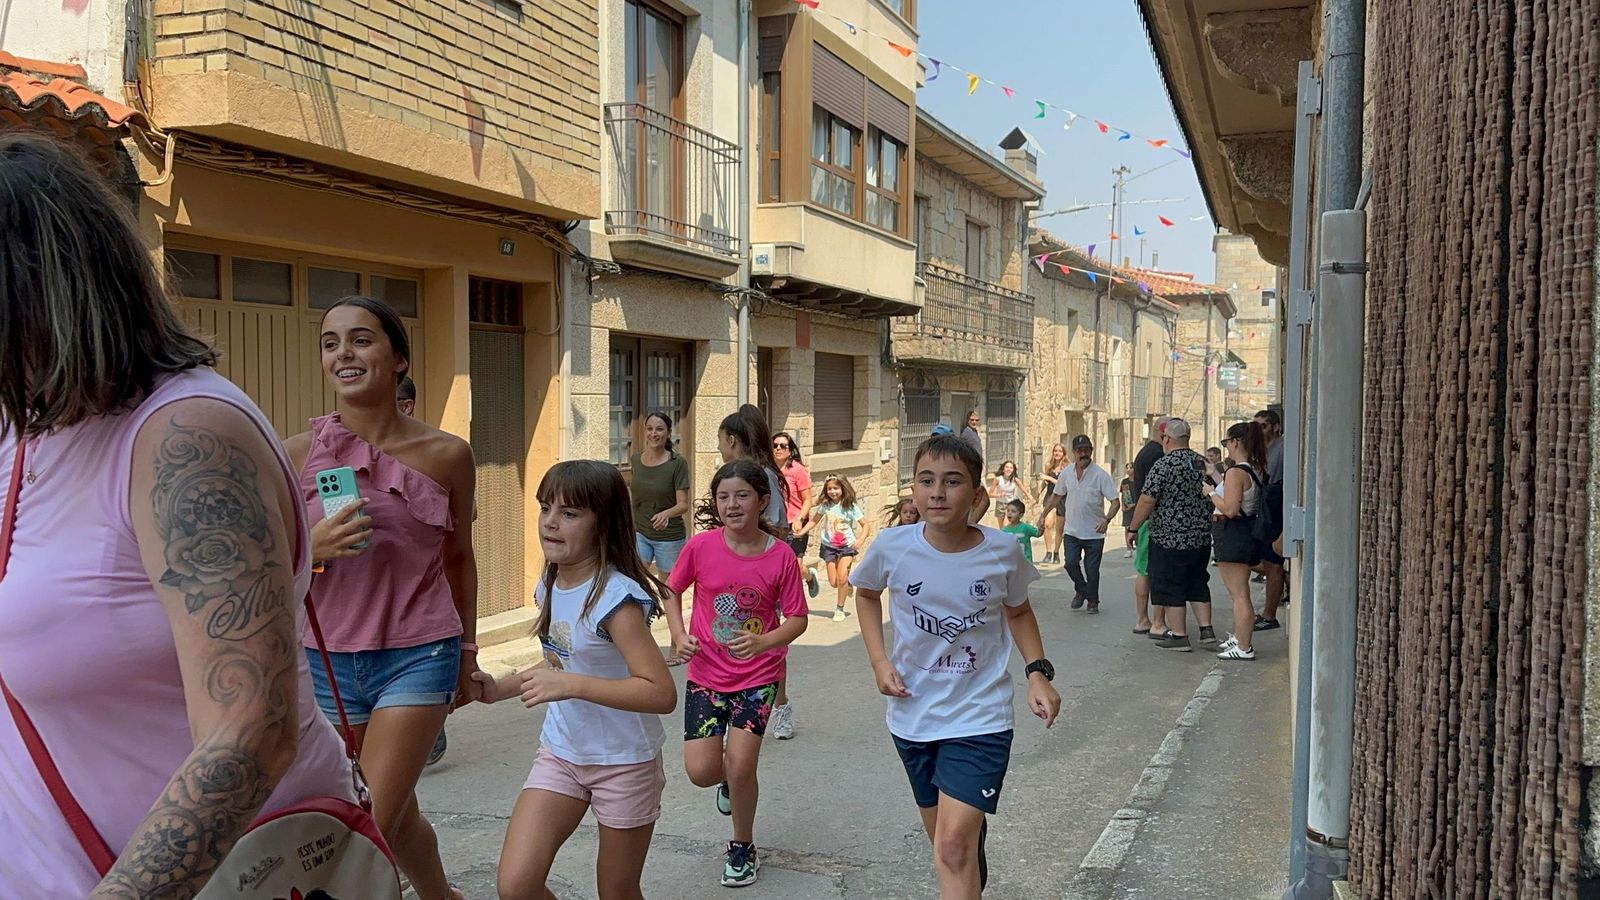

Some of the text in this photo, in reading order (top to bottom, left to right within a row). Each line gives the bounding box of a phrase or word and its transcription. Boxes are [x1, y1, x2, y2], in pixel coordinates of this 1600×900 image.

[503, 243, 511, 253] 18
[207, 574, 286, 640] Alba
[927, 654, 971, 670] Mirets
